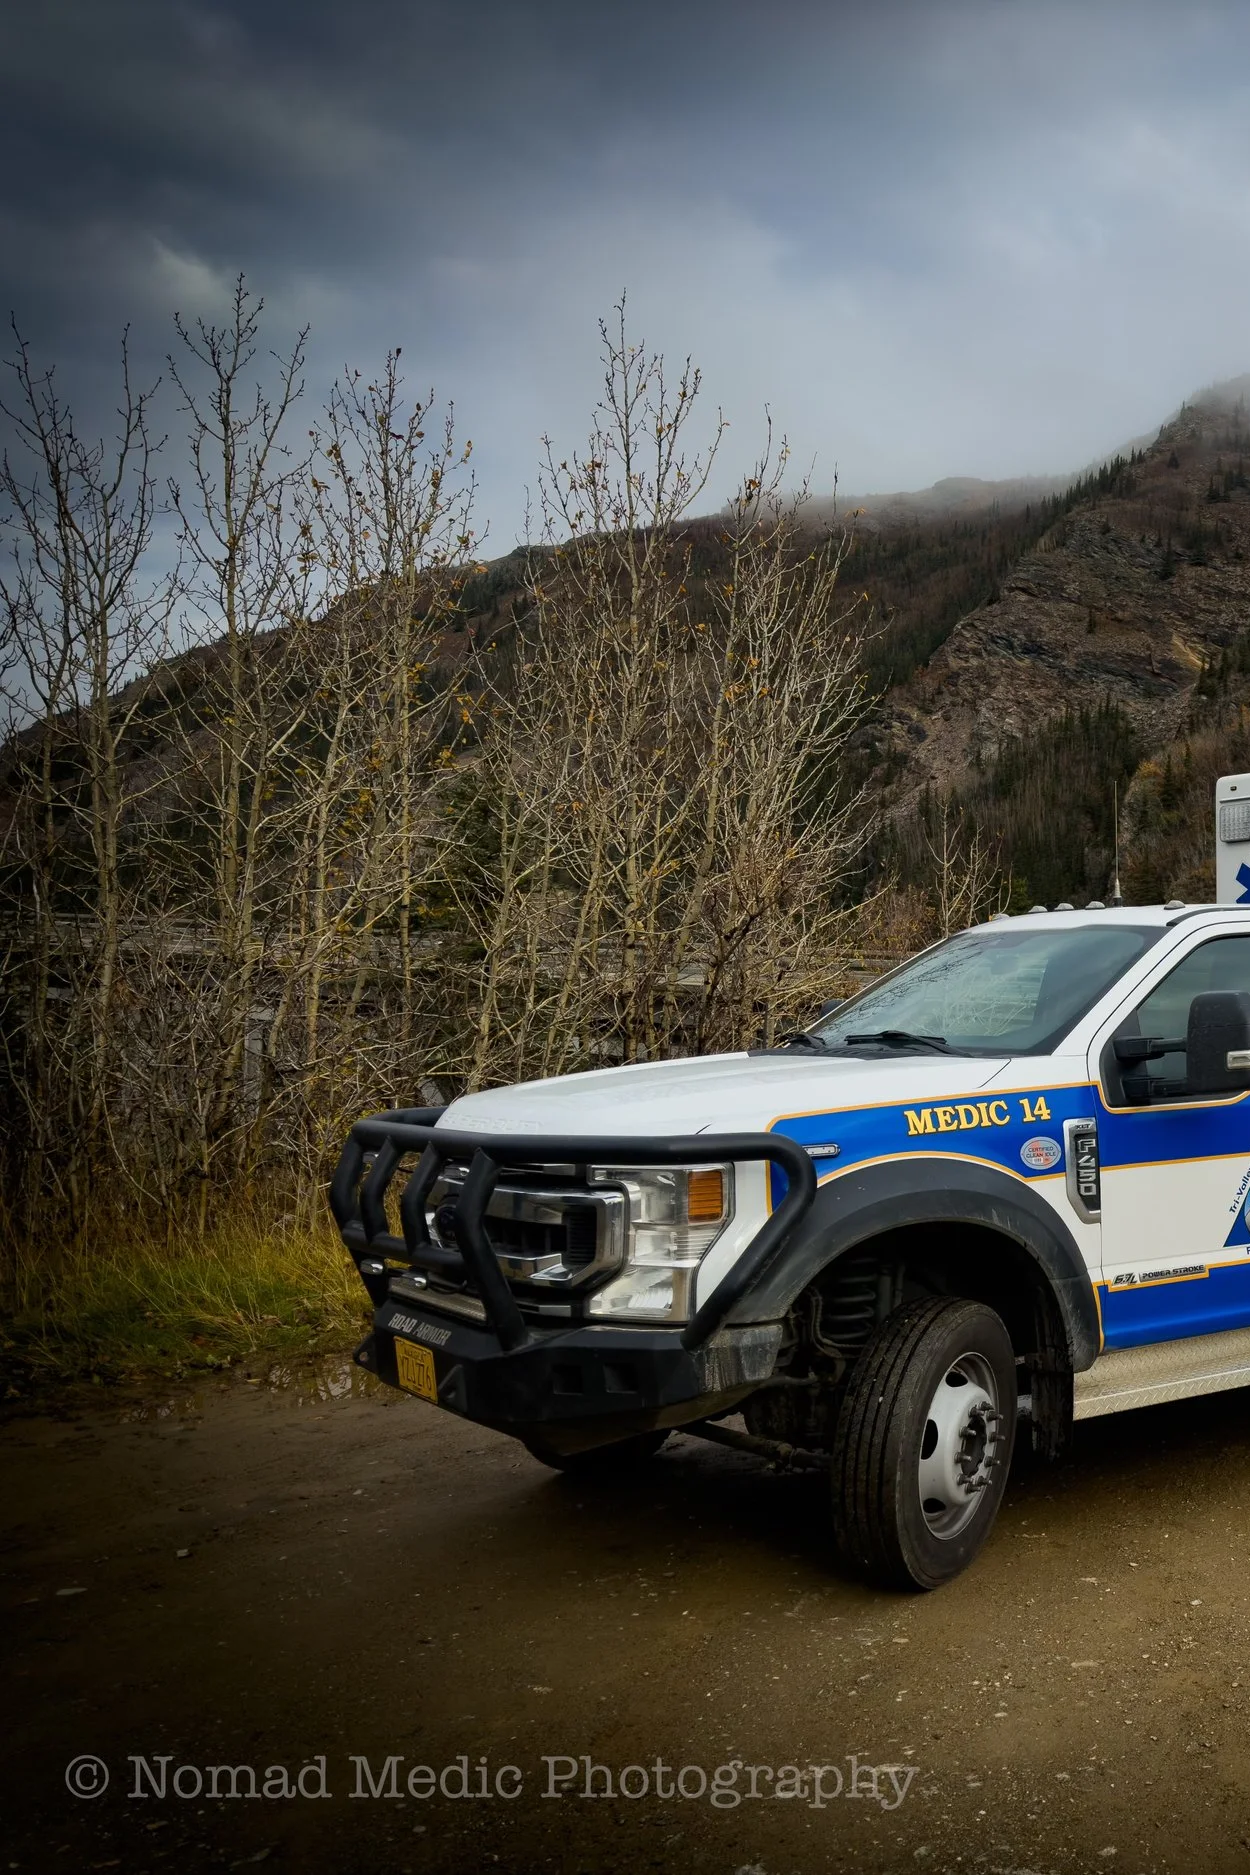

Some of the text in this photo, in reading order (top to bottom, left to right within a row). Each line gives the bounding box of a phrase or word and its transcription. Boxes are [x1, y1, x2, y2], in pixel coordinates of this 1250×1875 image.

[903, 1096, 1051, 1136] MEDIC 14
[1114, 1264, 1205, 1285] 6.7L POWER STROKE
[388, 1313, 452, 1346] ROAD ARMOR
